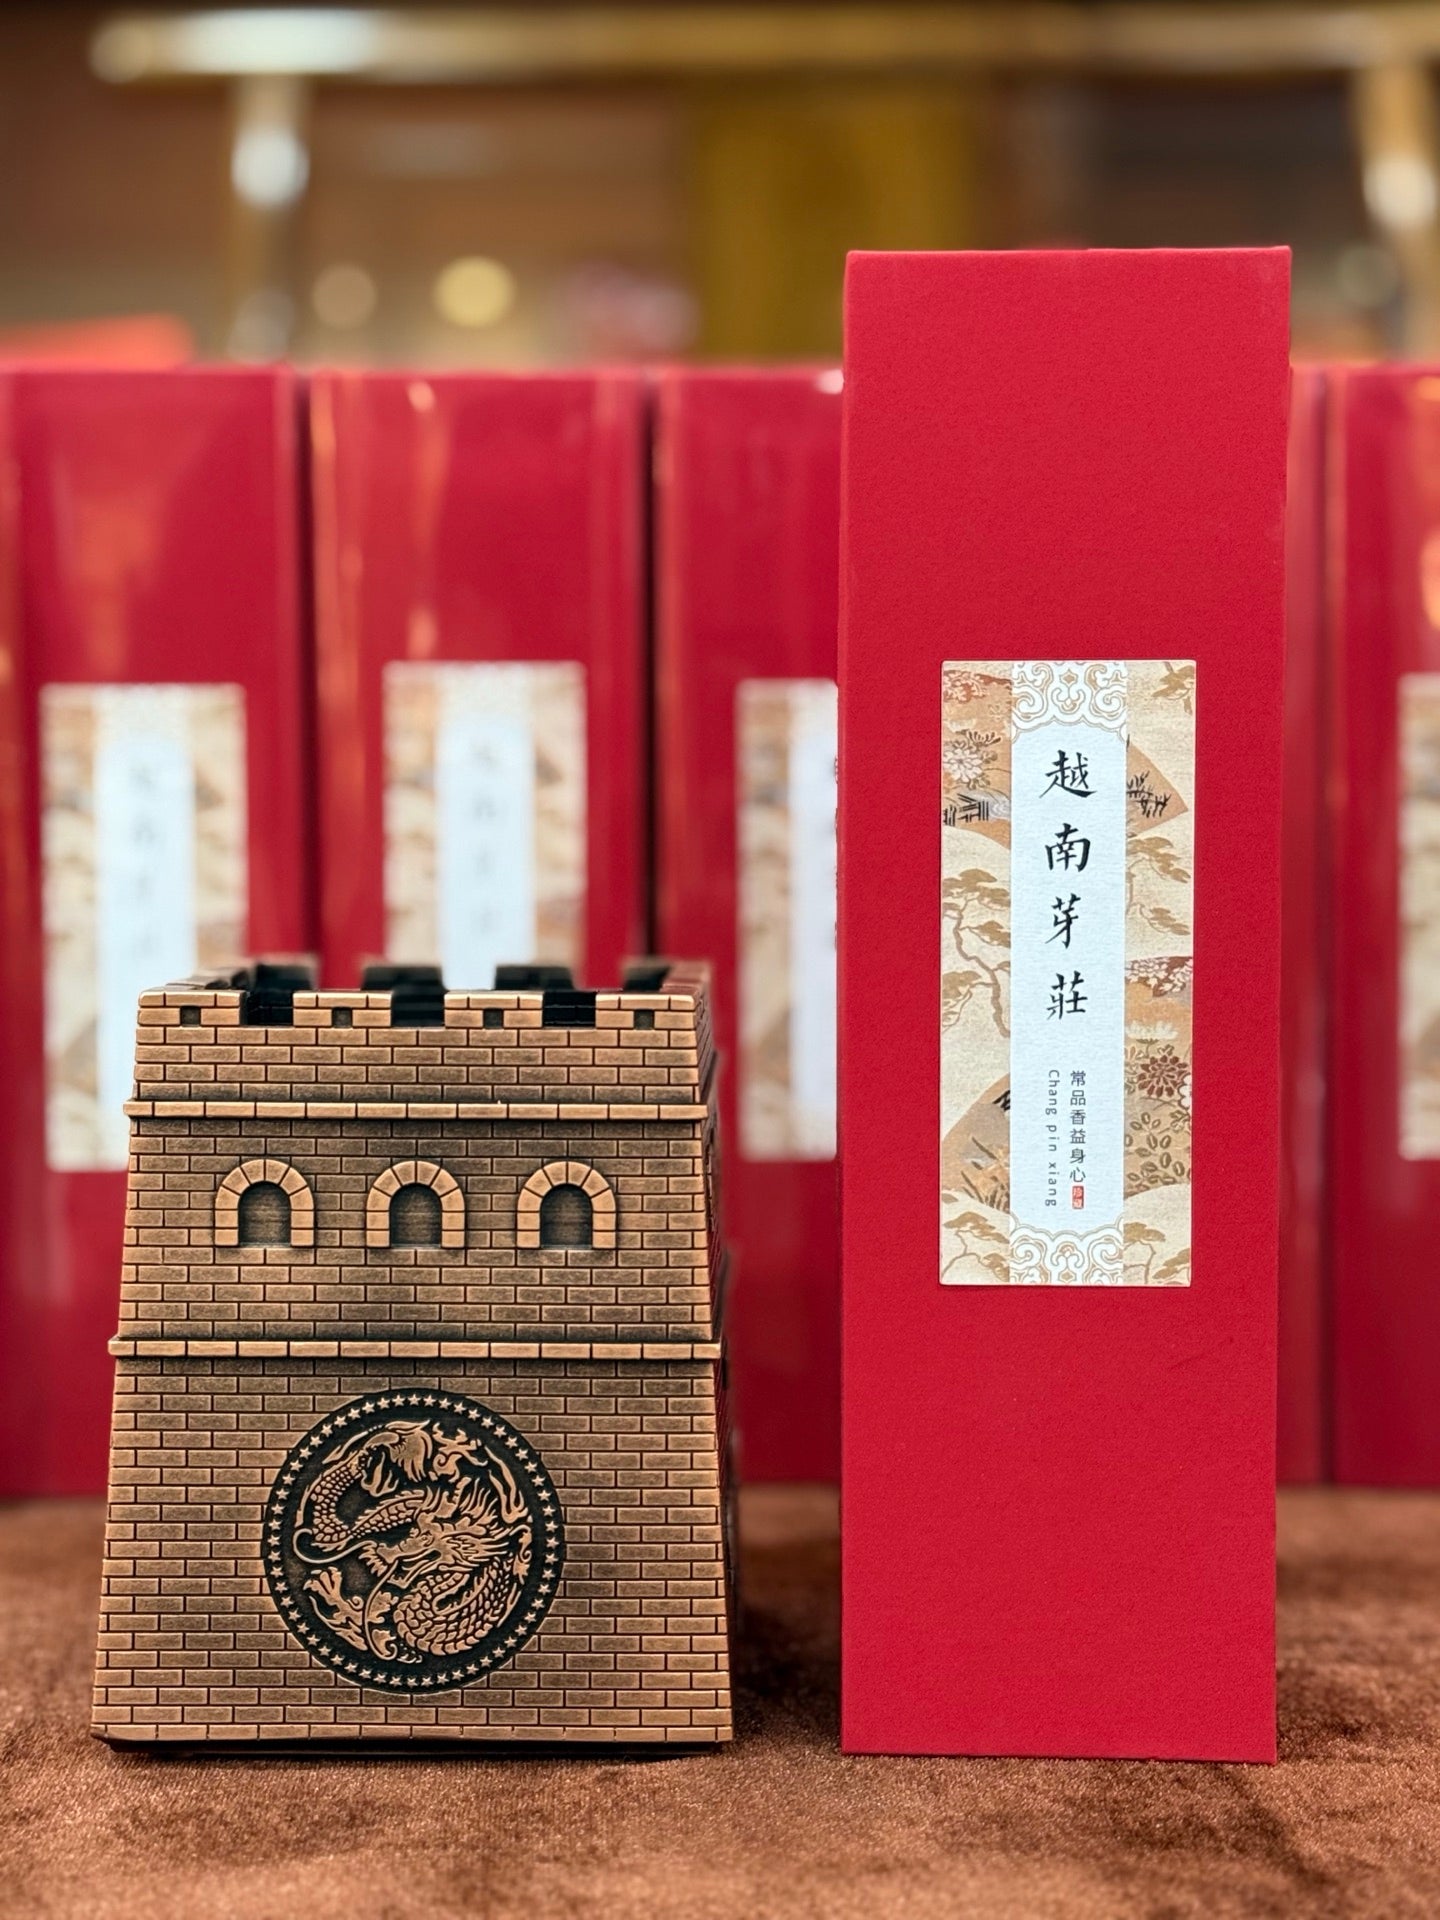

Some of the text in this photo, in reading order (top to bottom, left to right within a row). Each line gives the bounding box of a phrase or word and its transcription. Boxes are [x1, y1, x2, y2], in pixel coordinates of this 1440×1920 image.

[1039, 749, 1097, 1021] 越南芽莊
[1044, 1069, 1060, 1207] Chang pin xiang
[1069, 1069, 1087, 1183] 常品香益身心
